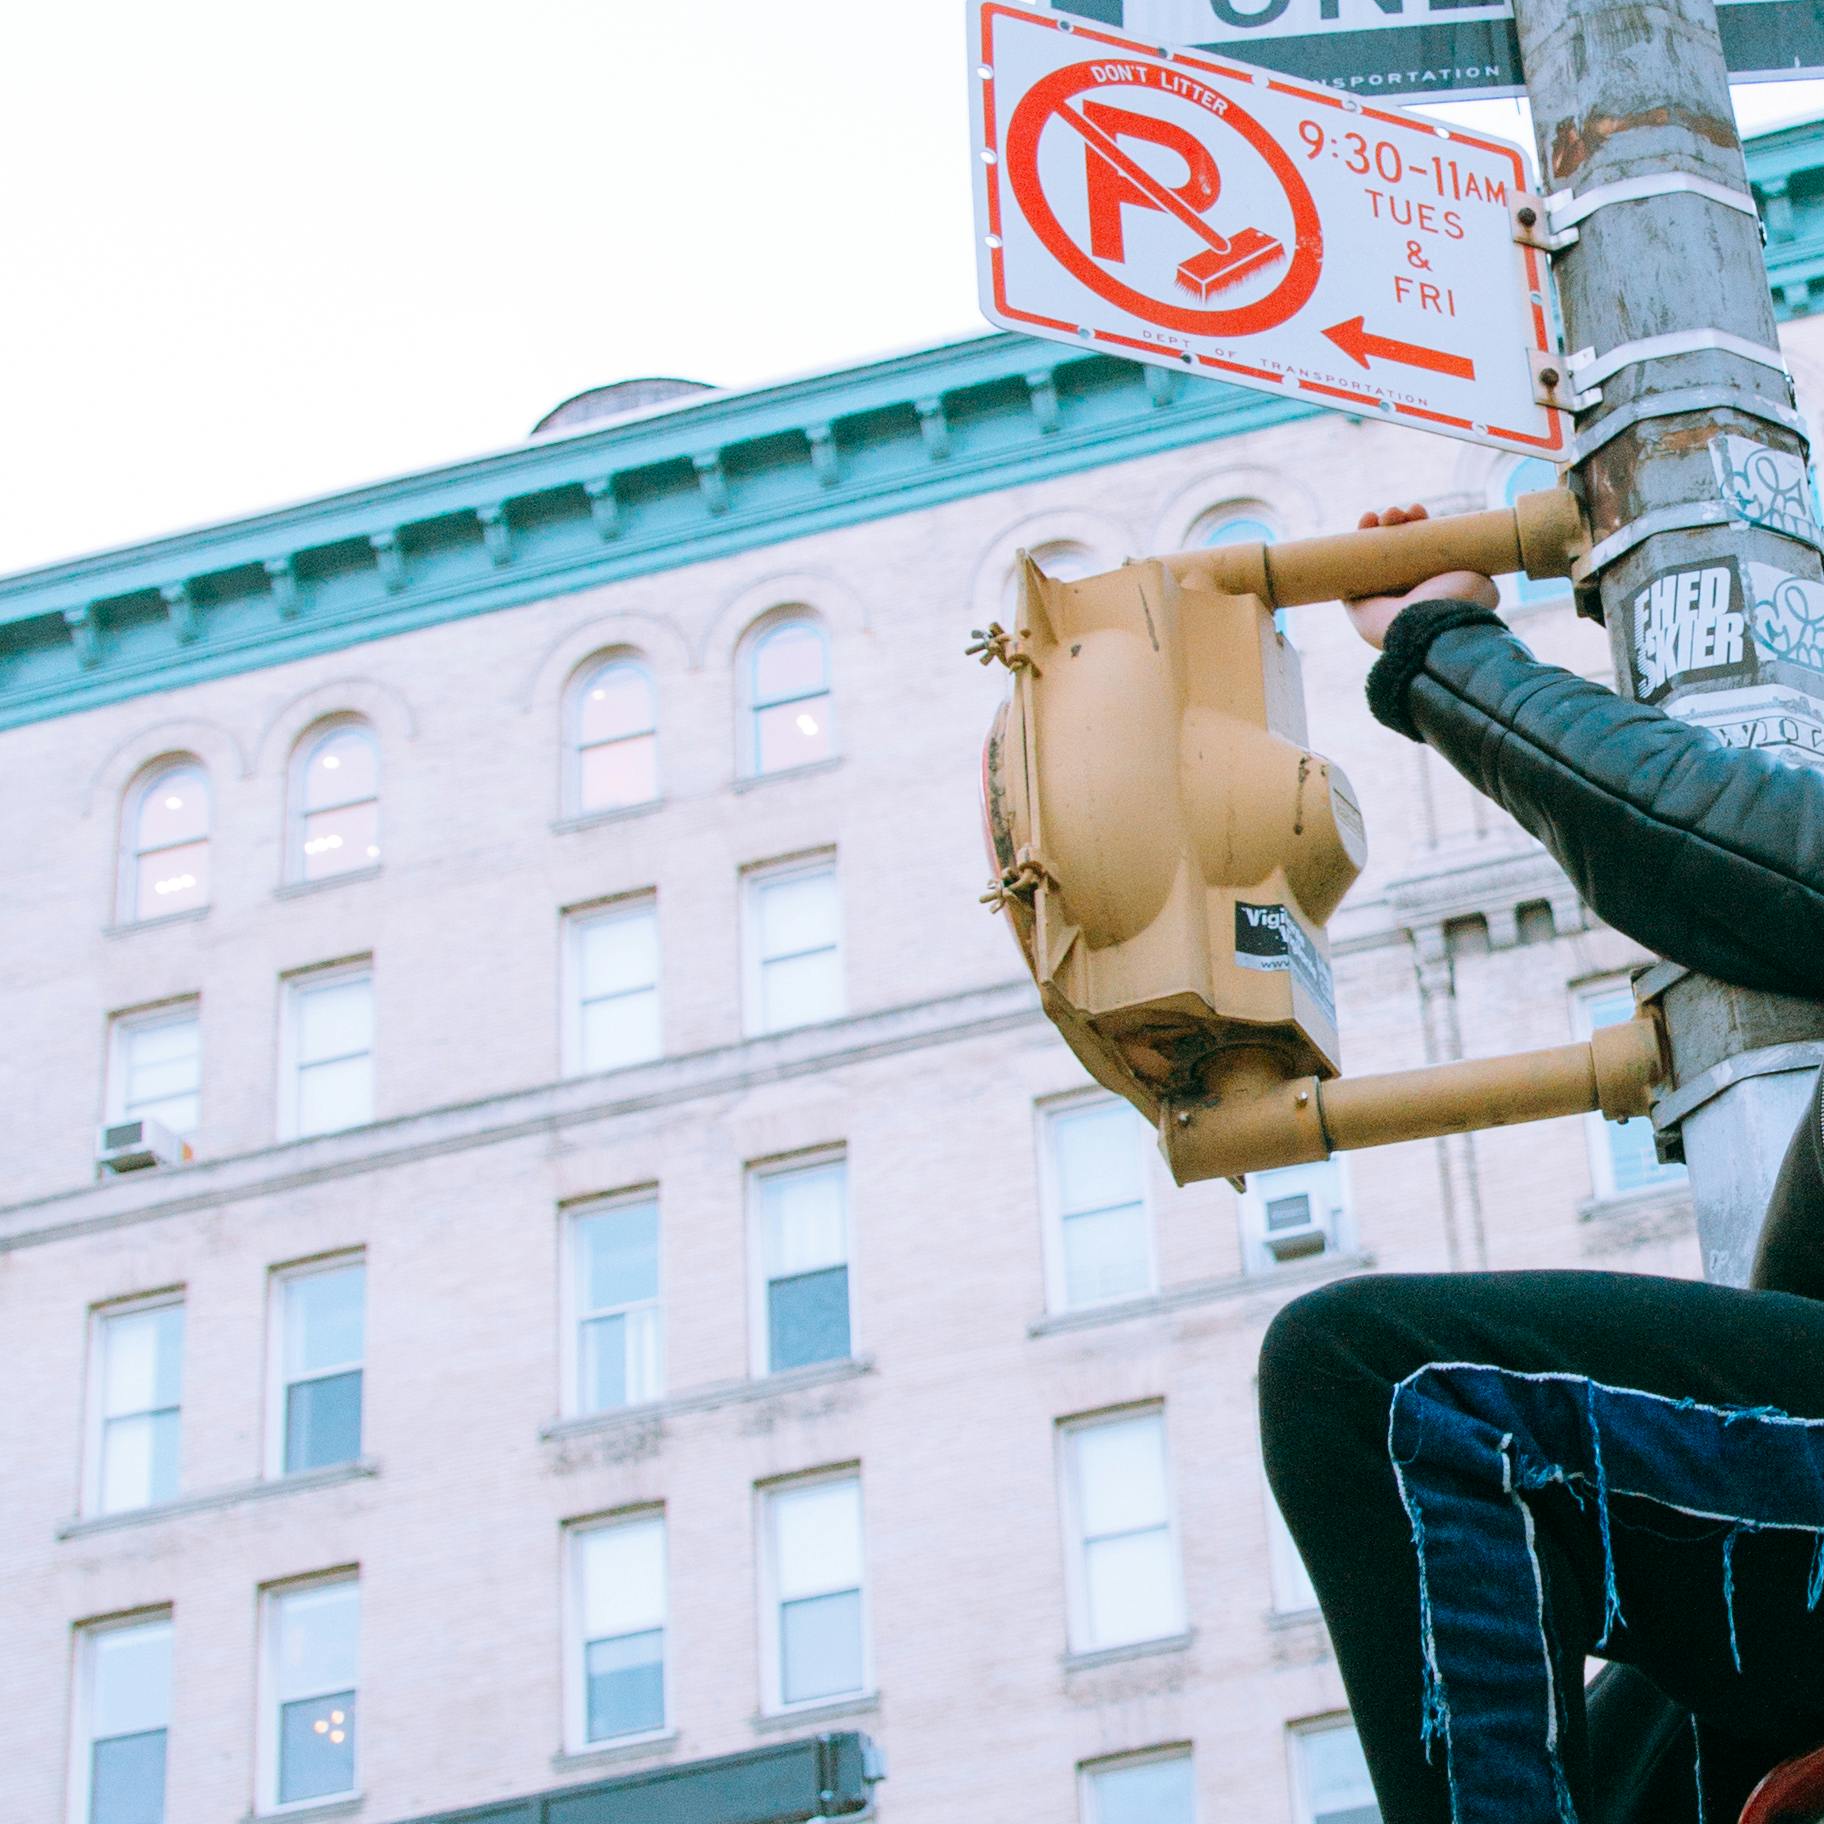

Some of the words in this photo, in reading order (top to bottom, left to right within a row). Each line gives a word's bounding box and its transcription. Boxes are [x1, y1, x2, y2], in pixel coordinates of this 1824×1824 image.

[1090, 63, 1147, 83] DON'T
[1160, 71, 1229, 116] LITTER
[1364, 188, 1466, 240] TUES
[1405, 239, 1432, 272] &
[1393, 274, 1457, 318] FRI
[1142, 330, 1191, 348] DEPT
[1214, 347, 1237, 359] OF
[1260, 358, 1429, 407] TRANSPORTATION
